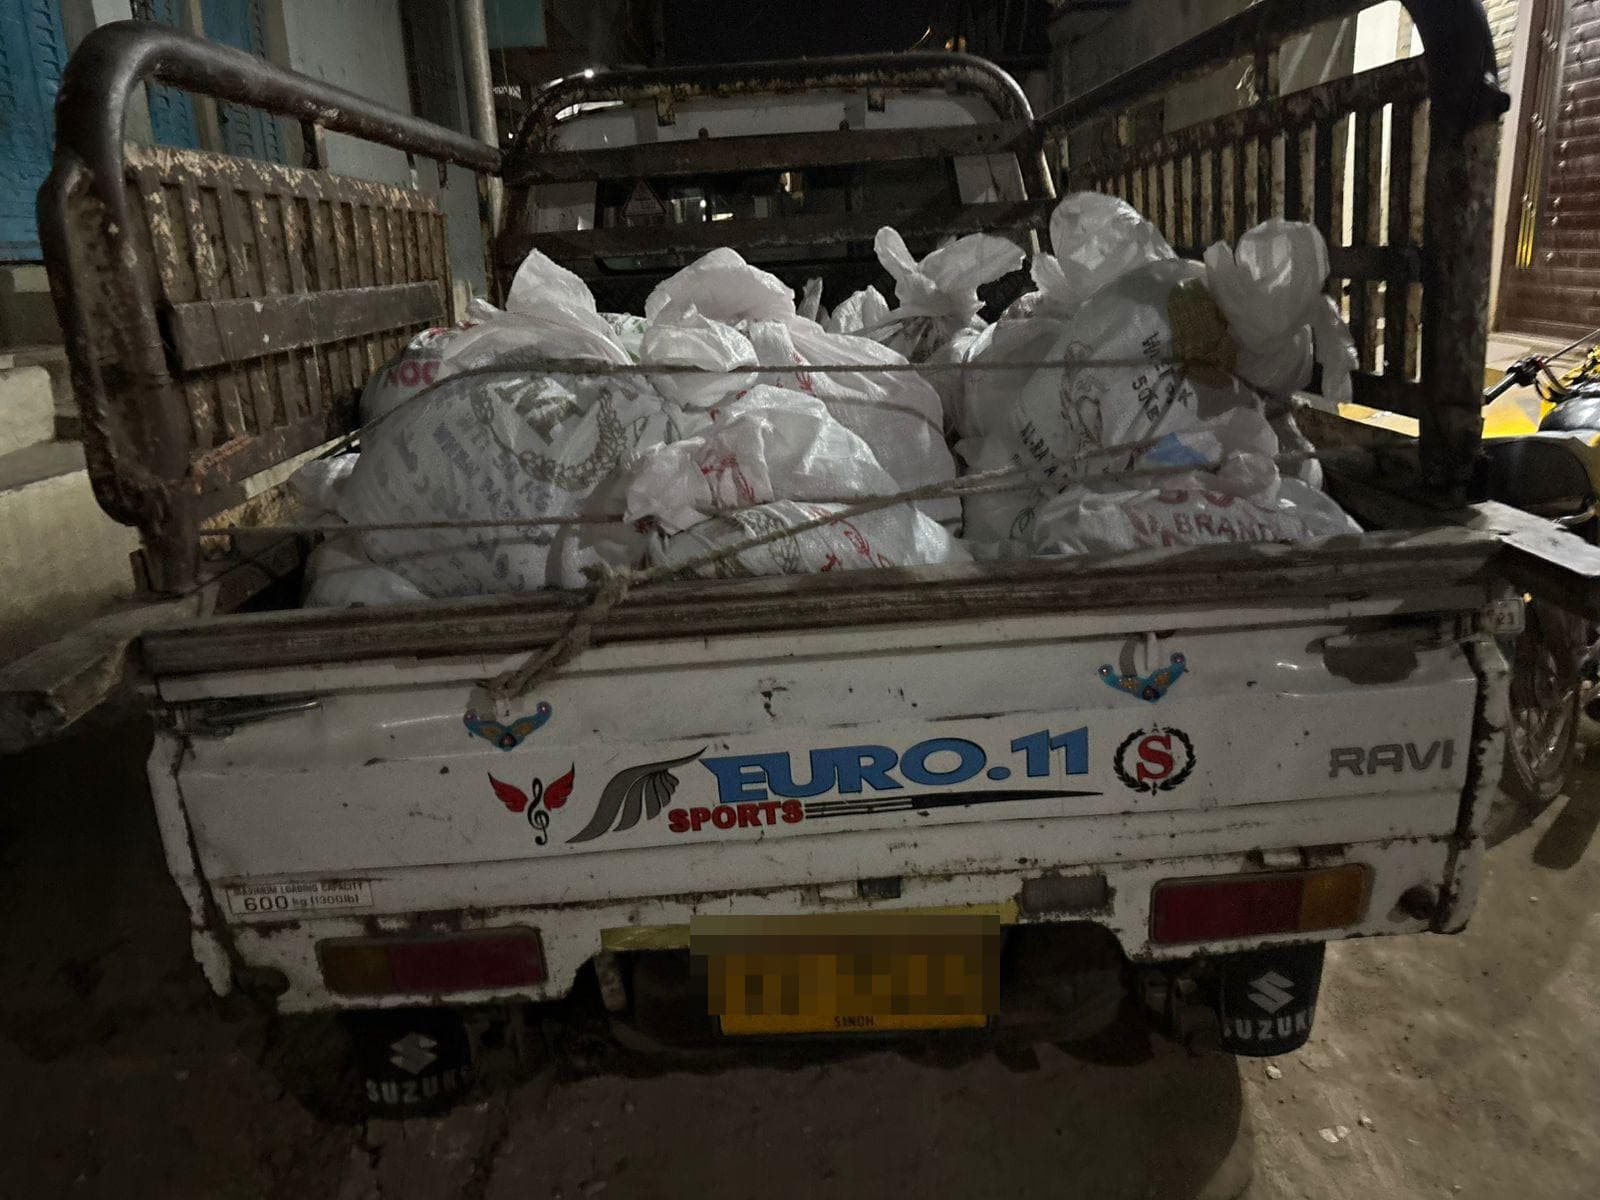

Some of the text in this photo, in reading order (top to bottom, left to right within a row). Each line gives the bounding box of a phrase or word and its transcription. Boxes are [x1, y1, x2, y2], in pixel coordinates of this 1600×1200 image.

[700, 727, 1090, 803] EURO.11
[1136, 735, 1174, 783] S
[1329, 740, 1453, 778] RAVI
[668, 800, 804, 833] SPORTS
[244, 895, 289, 912] 600
[833, 1015, 874, 1027] SINDH
